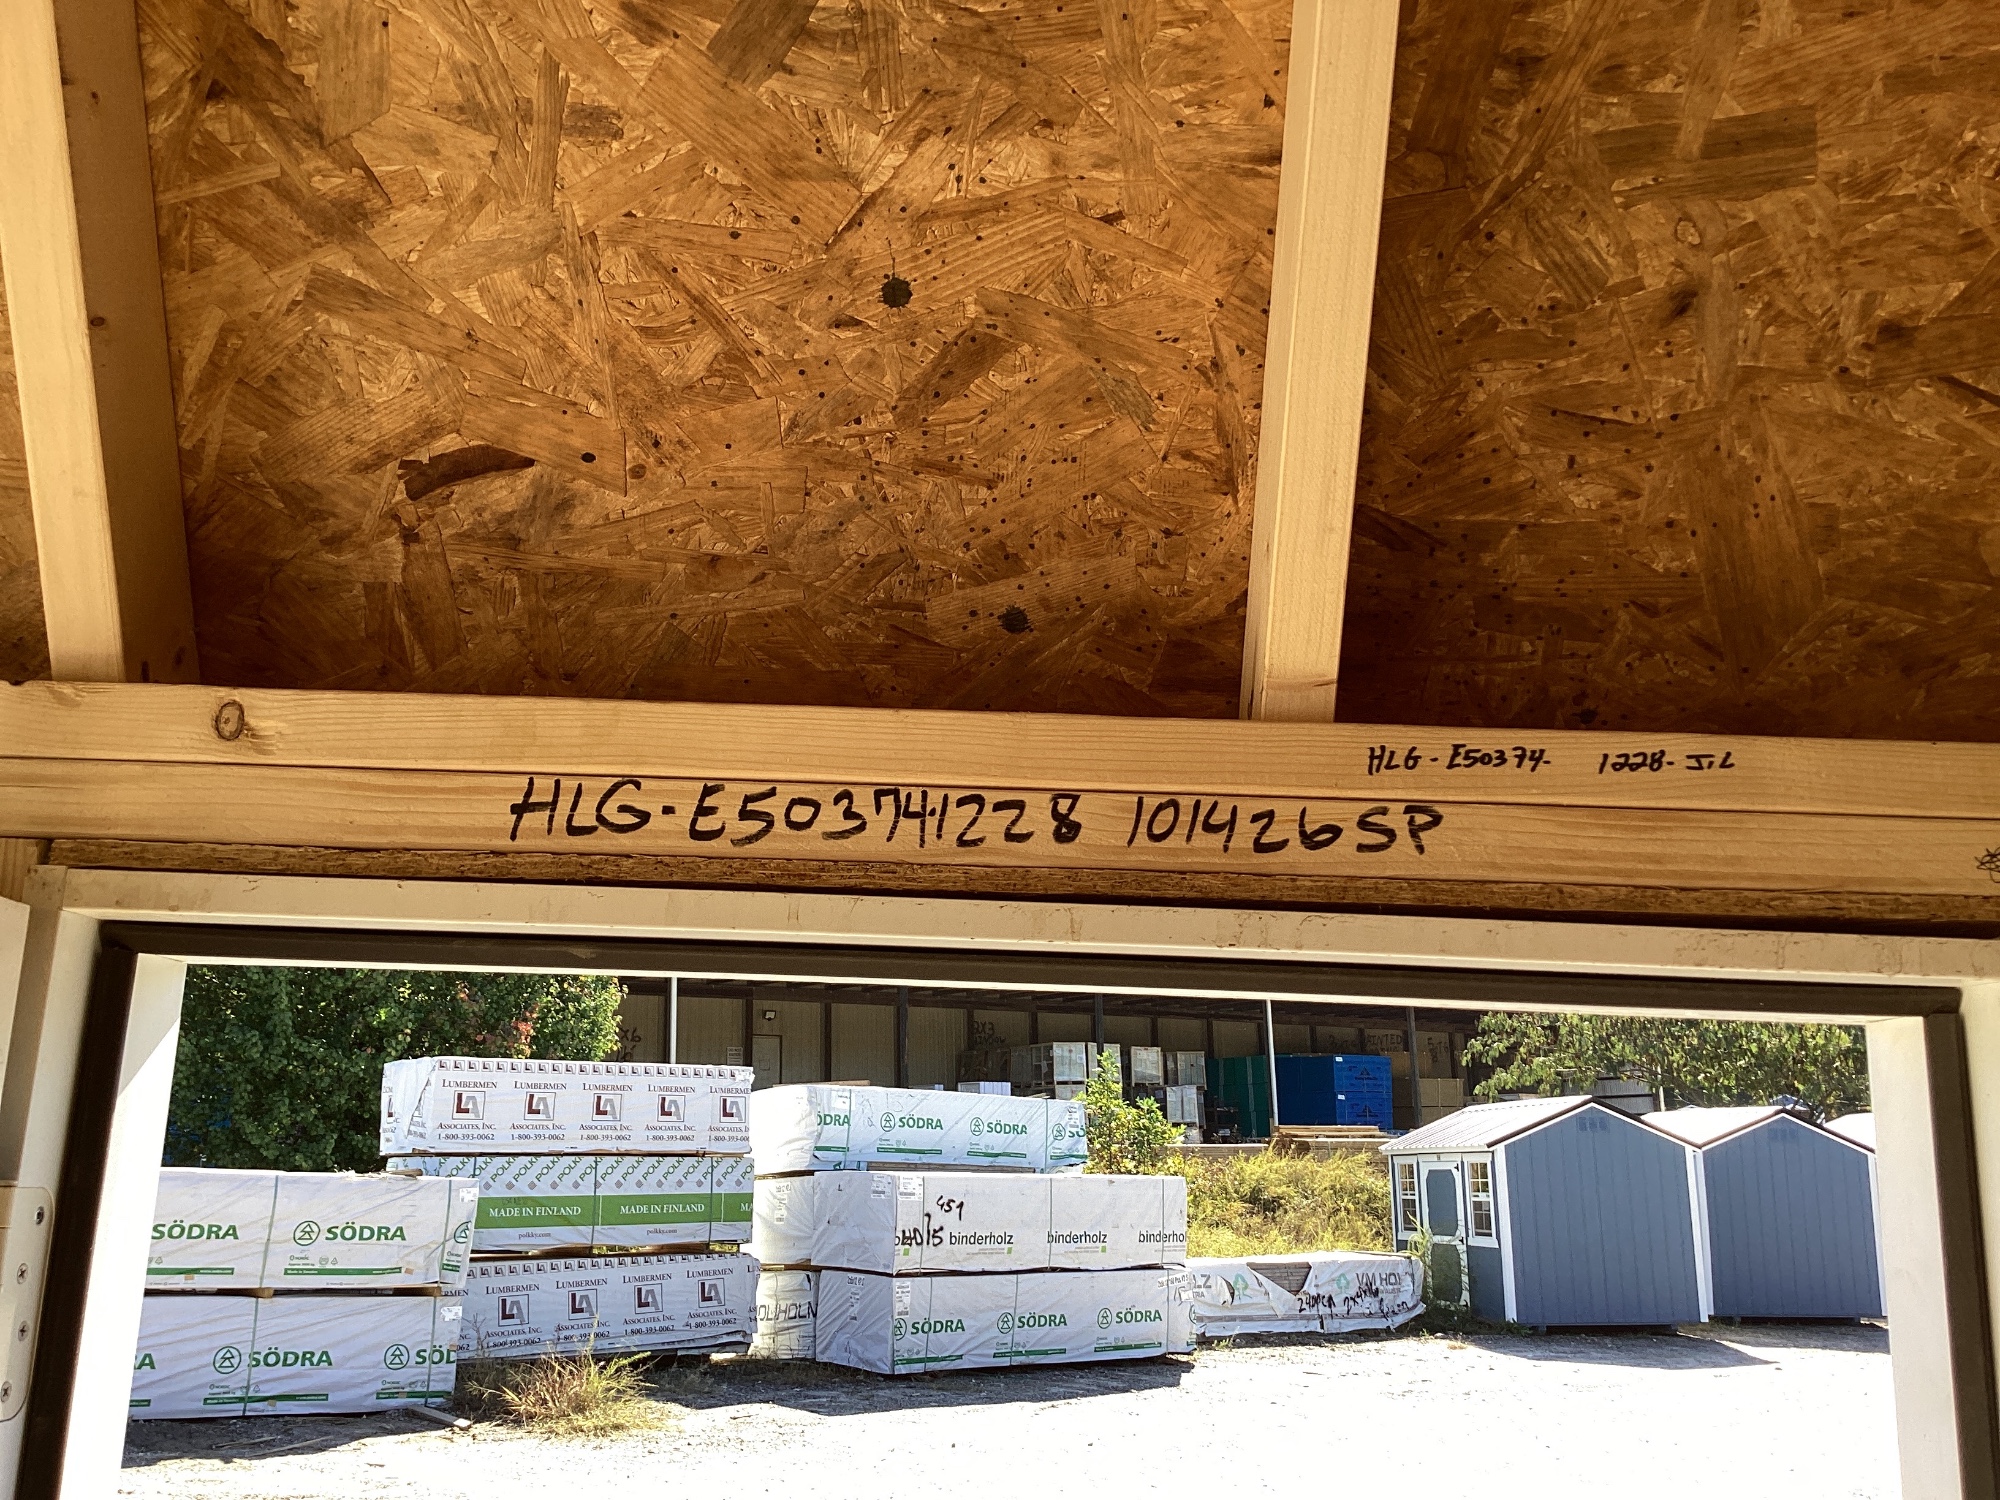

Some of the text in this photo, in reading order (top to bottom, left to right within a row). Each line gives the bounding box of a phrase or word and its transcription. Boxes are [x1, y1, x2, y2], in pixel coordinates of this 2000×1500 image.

[898, 1114, 943, 1130] SÖDRA
[986, 1119, 1028, 1135] SÖDRA
[438, 1133, 495, 1141] 1-800-393-0062
[511, 1133, 565, 1141] 1-800-393-0062
[646, 1134, 695, 1142] 1-800-393-0062
[489, 1206, 581, 1217] MADE IN FINLAND
[620, 1203, 705, 1214] MADE IN FINLAND
[151, 1219, 240, 1240] SÖDRA
[325, 1221, 406, 1241] SÖDRA
[1047, 1230, 1108, 1244] binderholz
[949, 1231, 1014, 1246] binderholz
[1017, 1312, 1068, 1329] SÖDRA
[1115, 1308, 1163, 1324] SÖDRA
[910, 1317, 966, 1335] SÖDRA
[246, 1347, 333, 1368] SÖDRA
